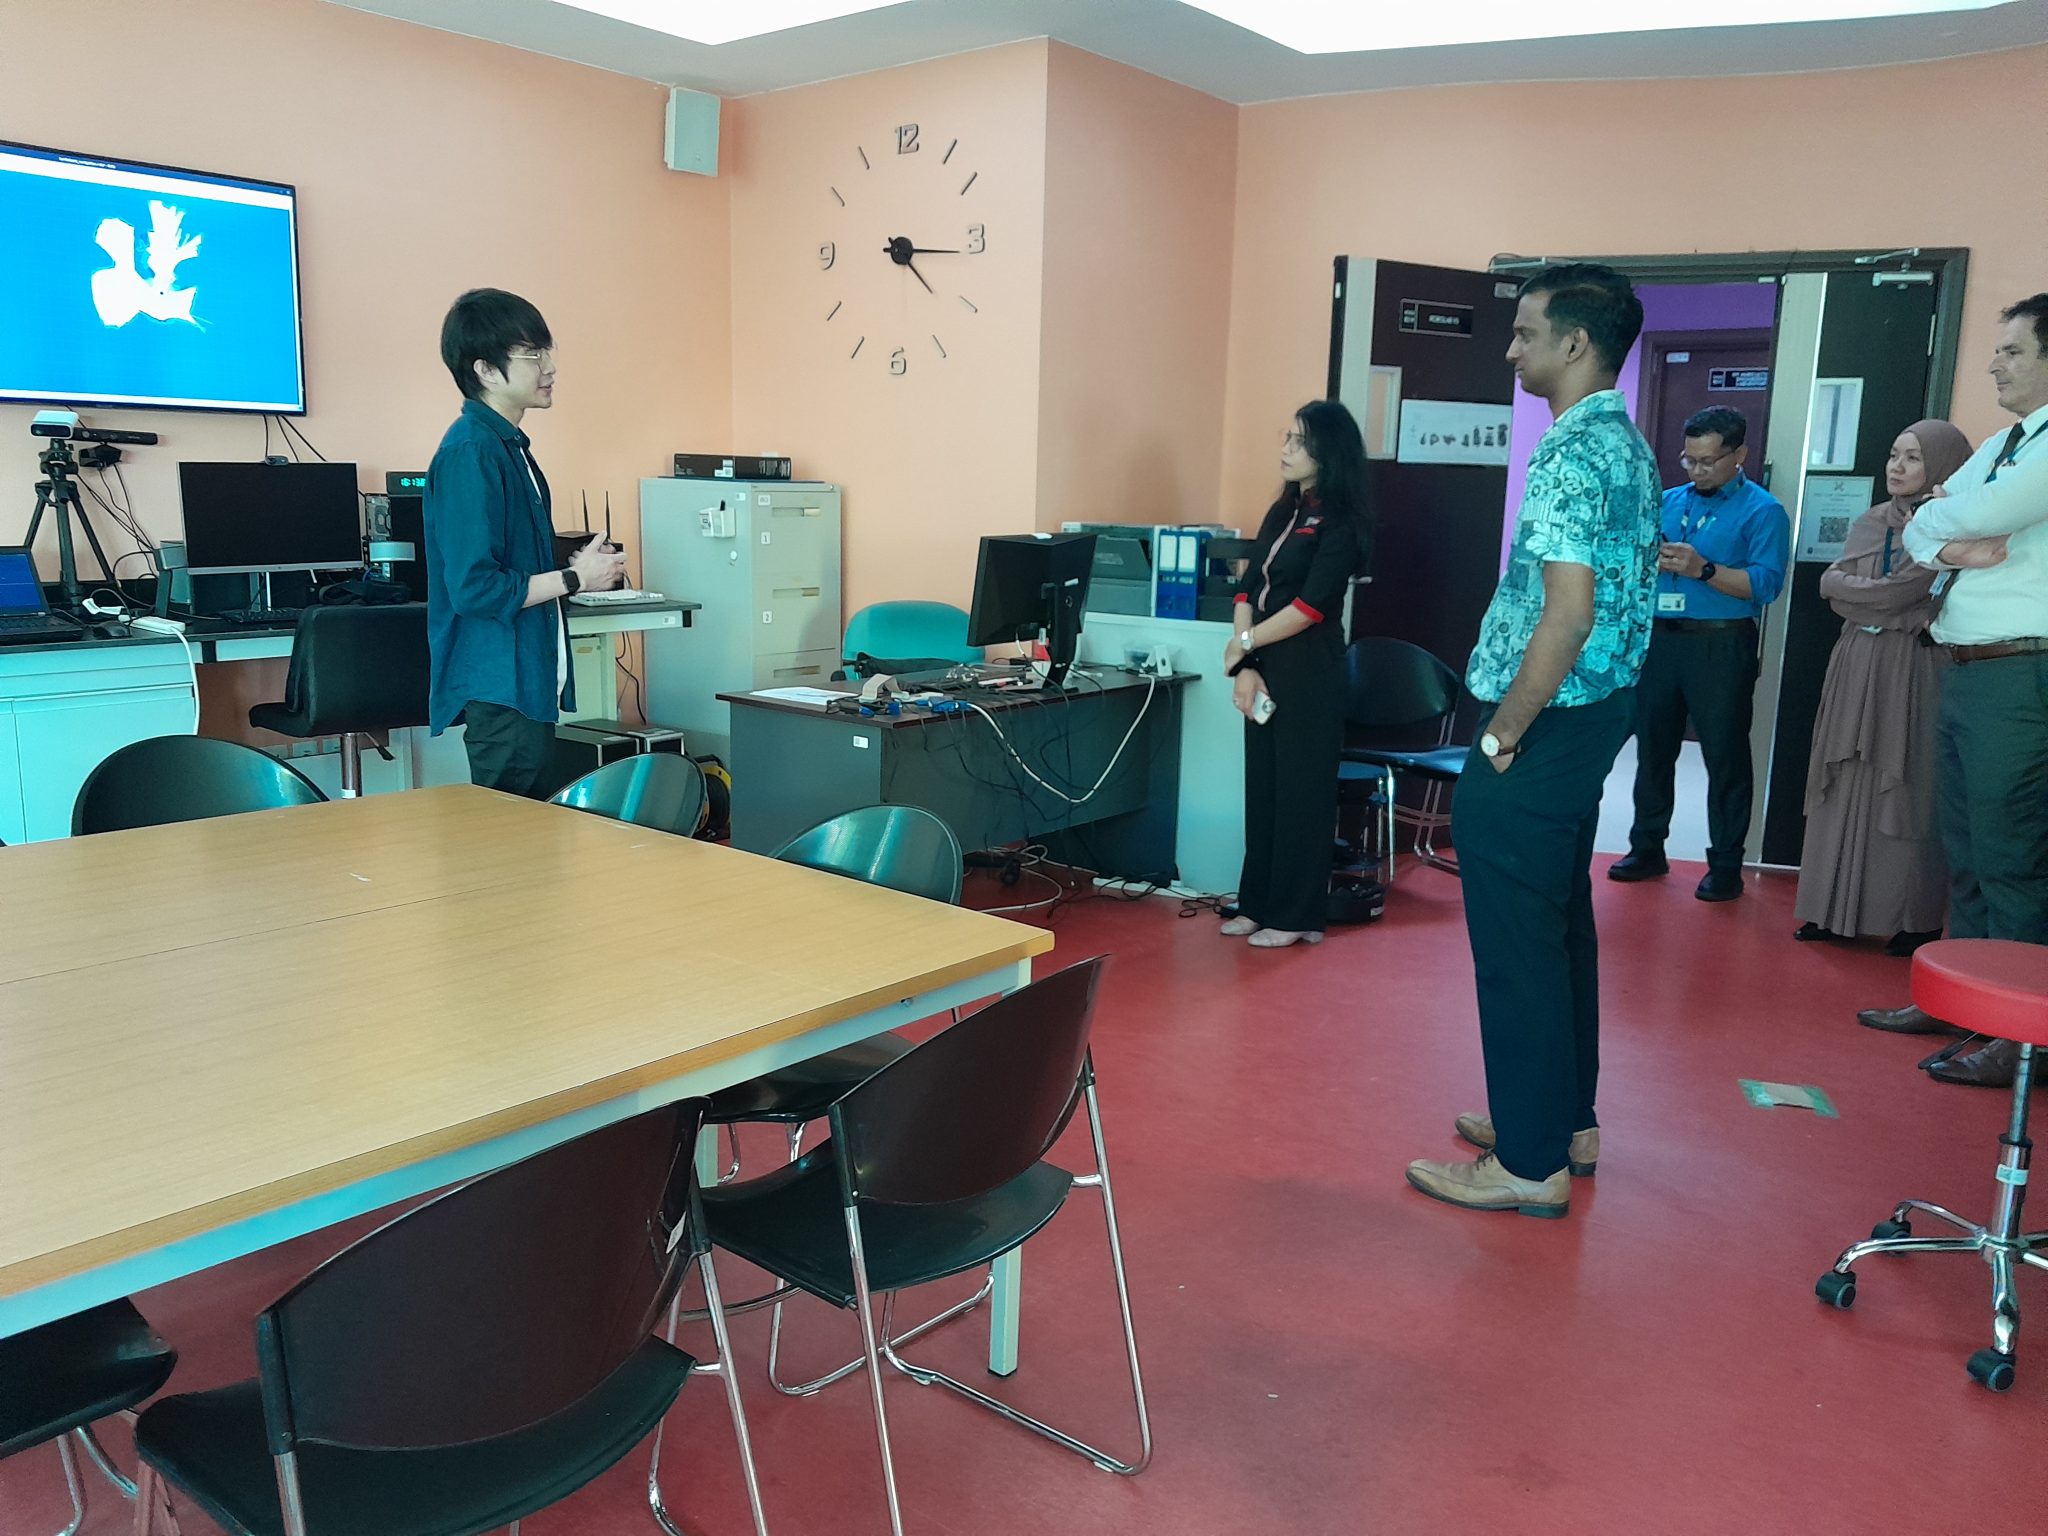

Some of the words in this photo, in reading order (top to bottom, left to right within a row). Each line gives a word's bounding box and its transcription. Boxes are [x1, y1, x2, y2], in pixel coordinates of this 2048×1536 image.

[895, 124, 920, 154] 12
[968, 224, 986, 254] 3
[818, 242, 835, 270] 9
[889, 347, 907, 375] 6
